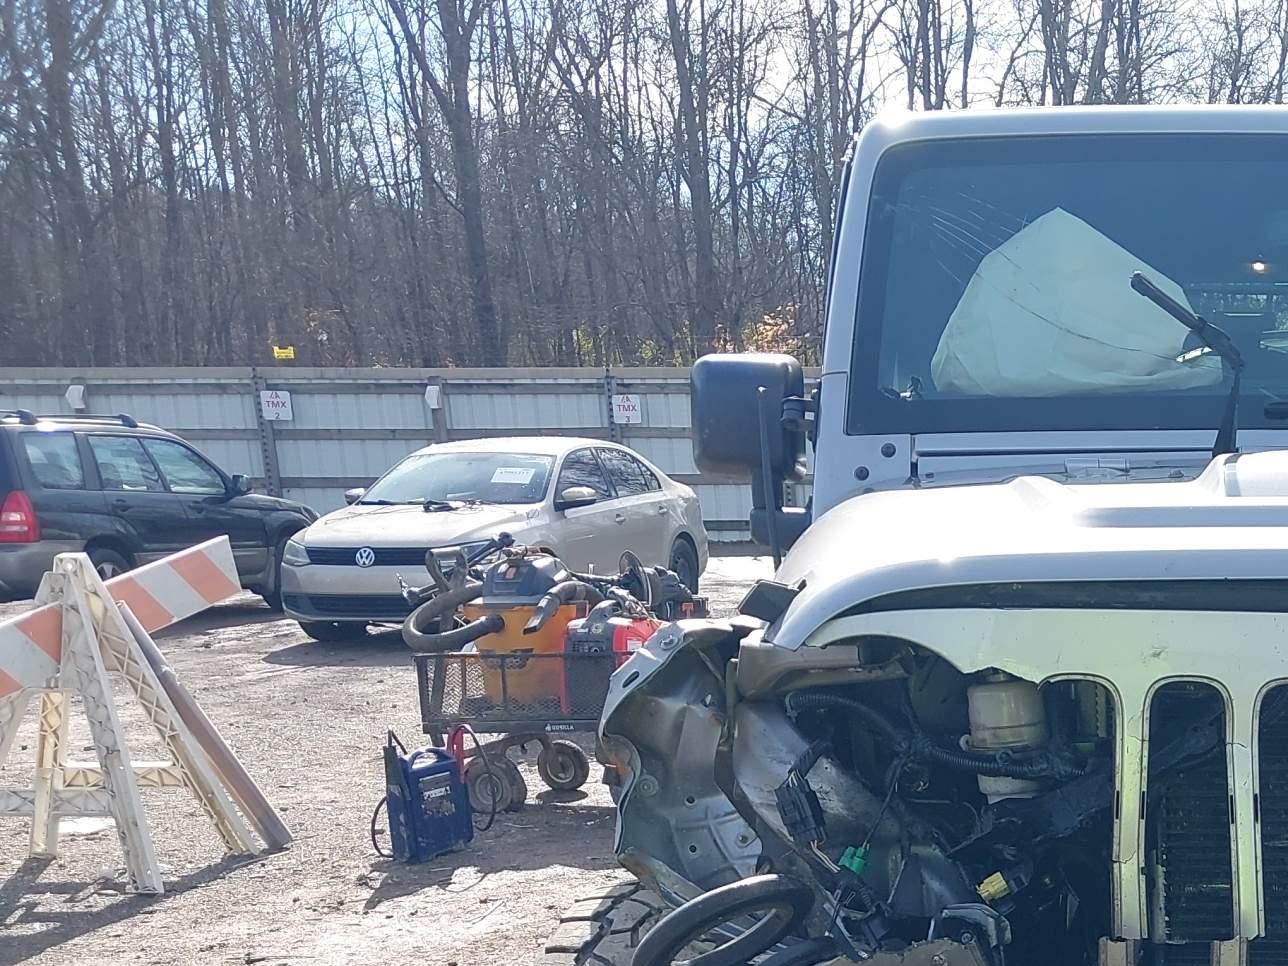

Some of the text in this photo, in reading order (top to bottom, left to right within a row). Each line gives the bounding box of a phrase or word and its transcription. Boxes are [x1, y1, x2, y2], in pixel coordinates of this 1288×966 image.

[265, 400, 288, 408] TMX
[616, 404, 637, 412] TMX
[274, 411, 280, 420] 2
